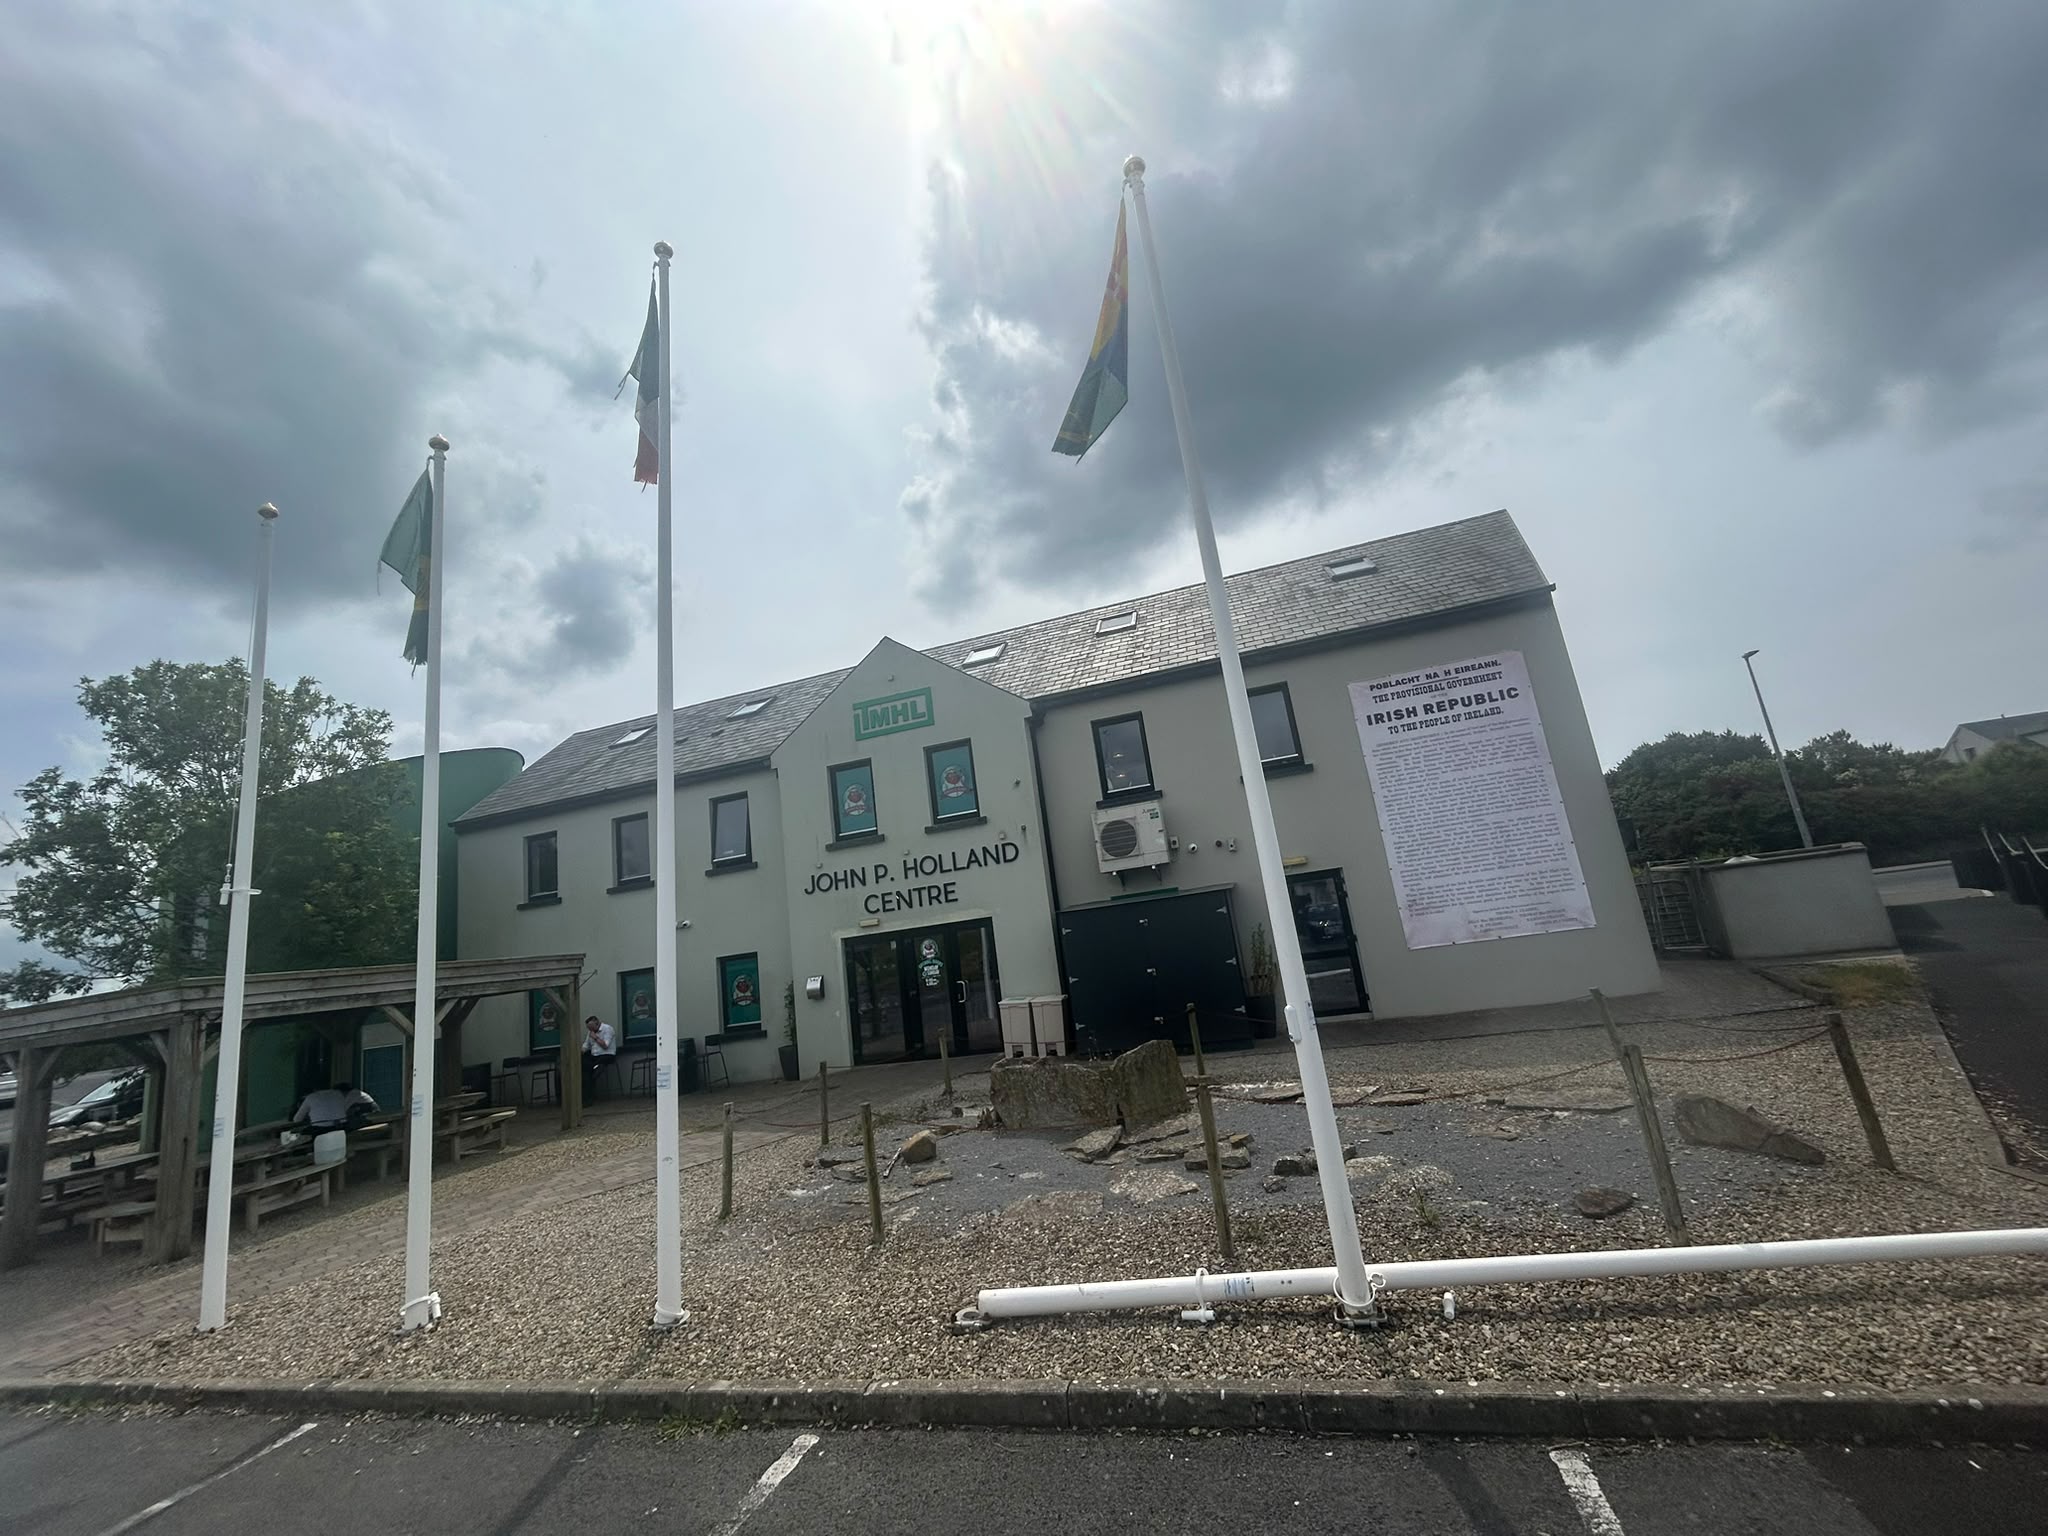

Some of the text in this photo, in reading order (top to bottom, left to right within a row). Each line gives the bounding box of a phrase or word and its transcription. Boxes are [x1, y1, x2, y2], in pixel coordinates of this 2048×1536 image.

[1369, 675, 1421, 691] POBLACHT
[1425, 671, 1440, 681] NA
[1444, 669, 1452, 677] H
[1372, 671, 1503, 704] THE PROVISIONAL GOVERNMENT
[1366, 686, 1520, 726] IRISH REPUBLIC
[1387, 724, 1400, 735] TO
[1400, 721, 1418, 733] THE
[1419, 714, 1451, 729] PEOPLE
[1451, 713, 1463, 723] OF
[803, 841, 1020, 896] JOHN P. HOLLAND
[863, 881, 959, 914] CENTRE
